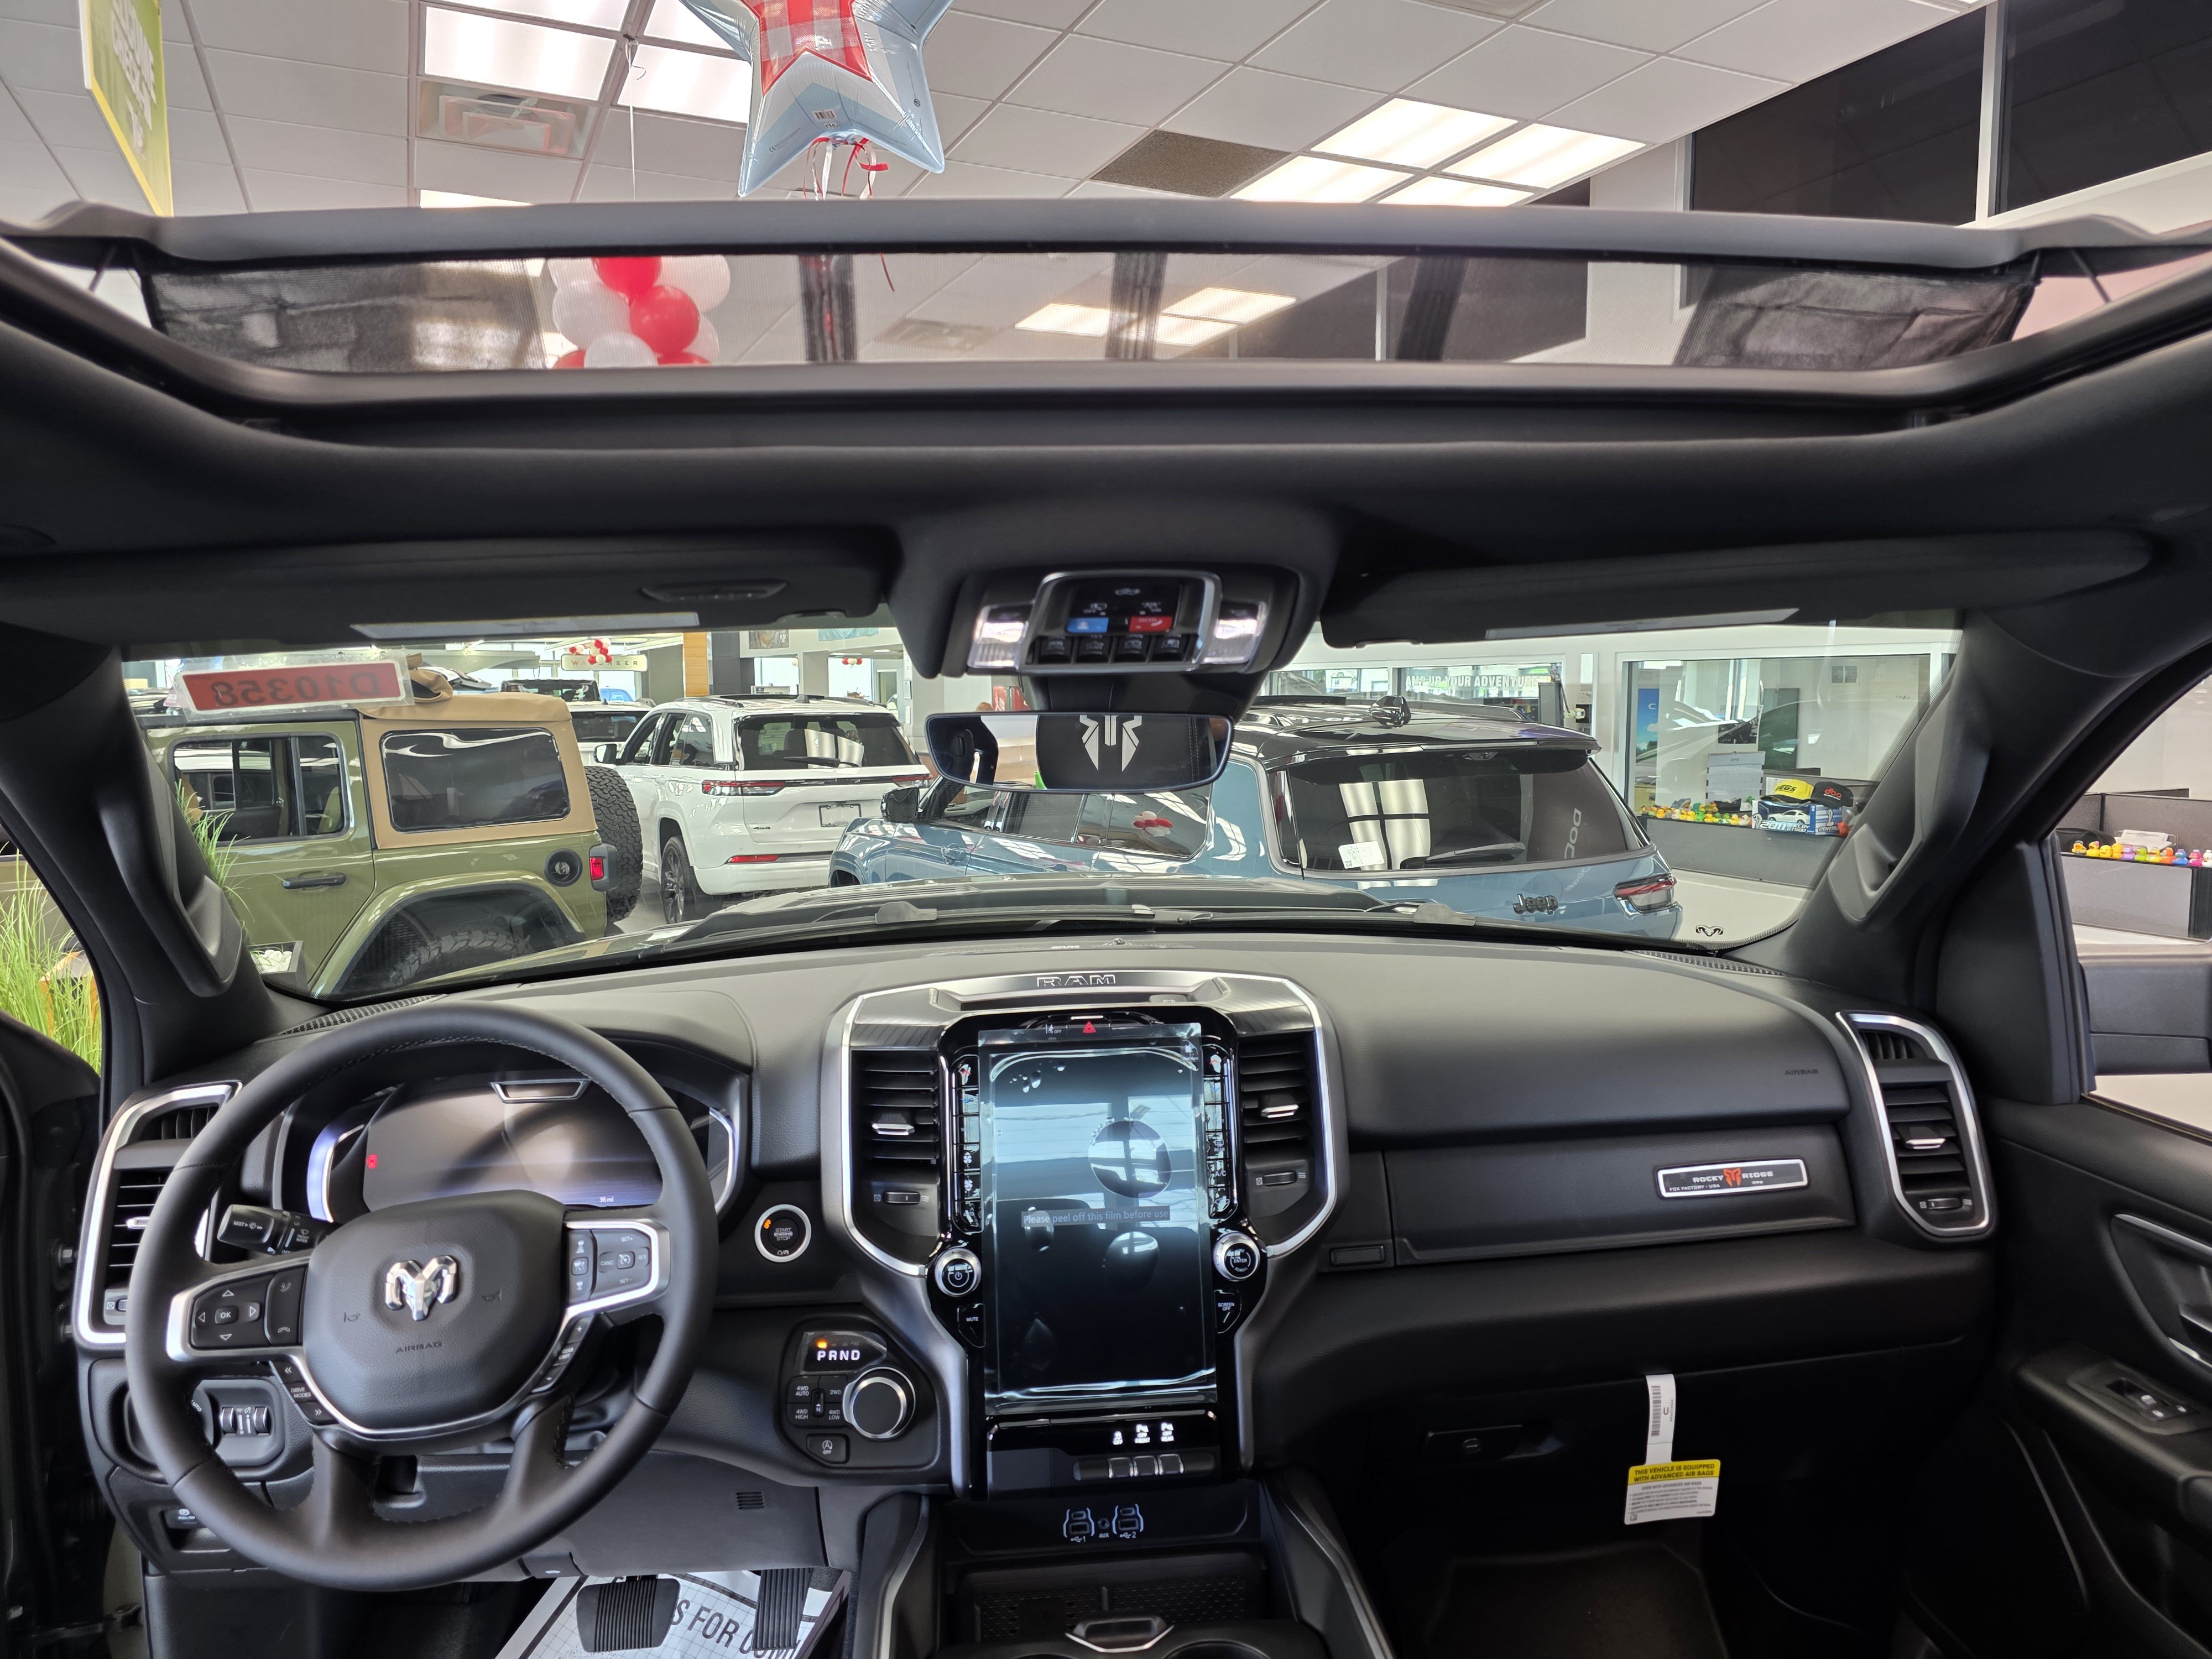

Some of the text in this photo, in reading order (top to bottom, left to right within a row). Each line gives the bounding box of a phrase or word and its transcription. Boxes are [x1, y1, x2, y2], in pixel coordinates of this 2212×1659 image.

[1429, 676, 1442, 686] UP
[1445, 675, 1471, 687] YOUR
[1824, 787, 1842, 798] dba
[1760, 821, 1787, 831] 2011
[1513, 894, 1559, 915] Jeep
[1037, 974, 1116, 987] RAM
[1024, 1215, 1050, 1224] Please
[1052, 1214, 1070, 1224] peel
[1073, 1212, 1086, 1221] off
[1088, 1211, 1103, 1220] this
[1106, 1210, 1121, 1219] film
[1124, 1209, 1151, 1219] before
[396, 1341, 442, 1353] AIRBAG
[1651, 1472, 1684, 1480] ADVANCED
[688, 1605, 740, 1648] FOR
